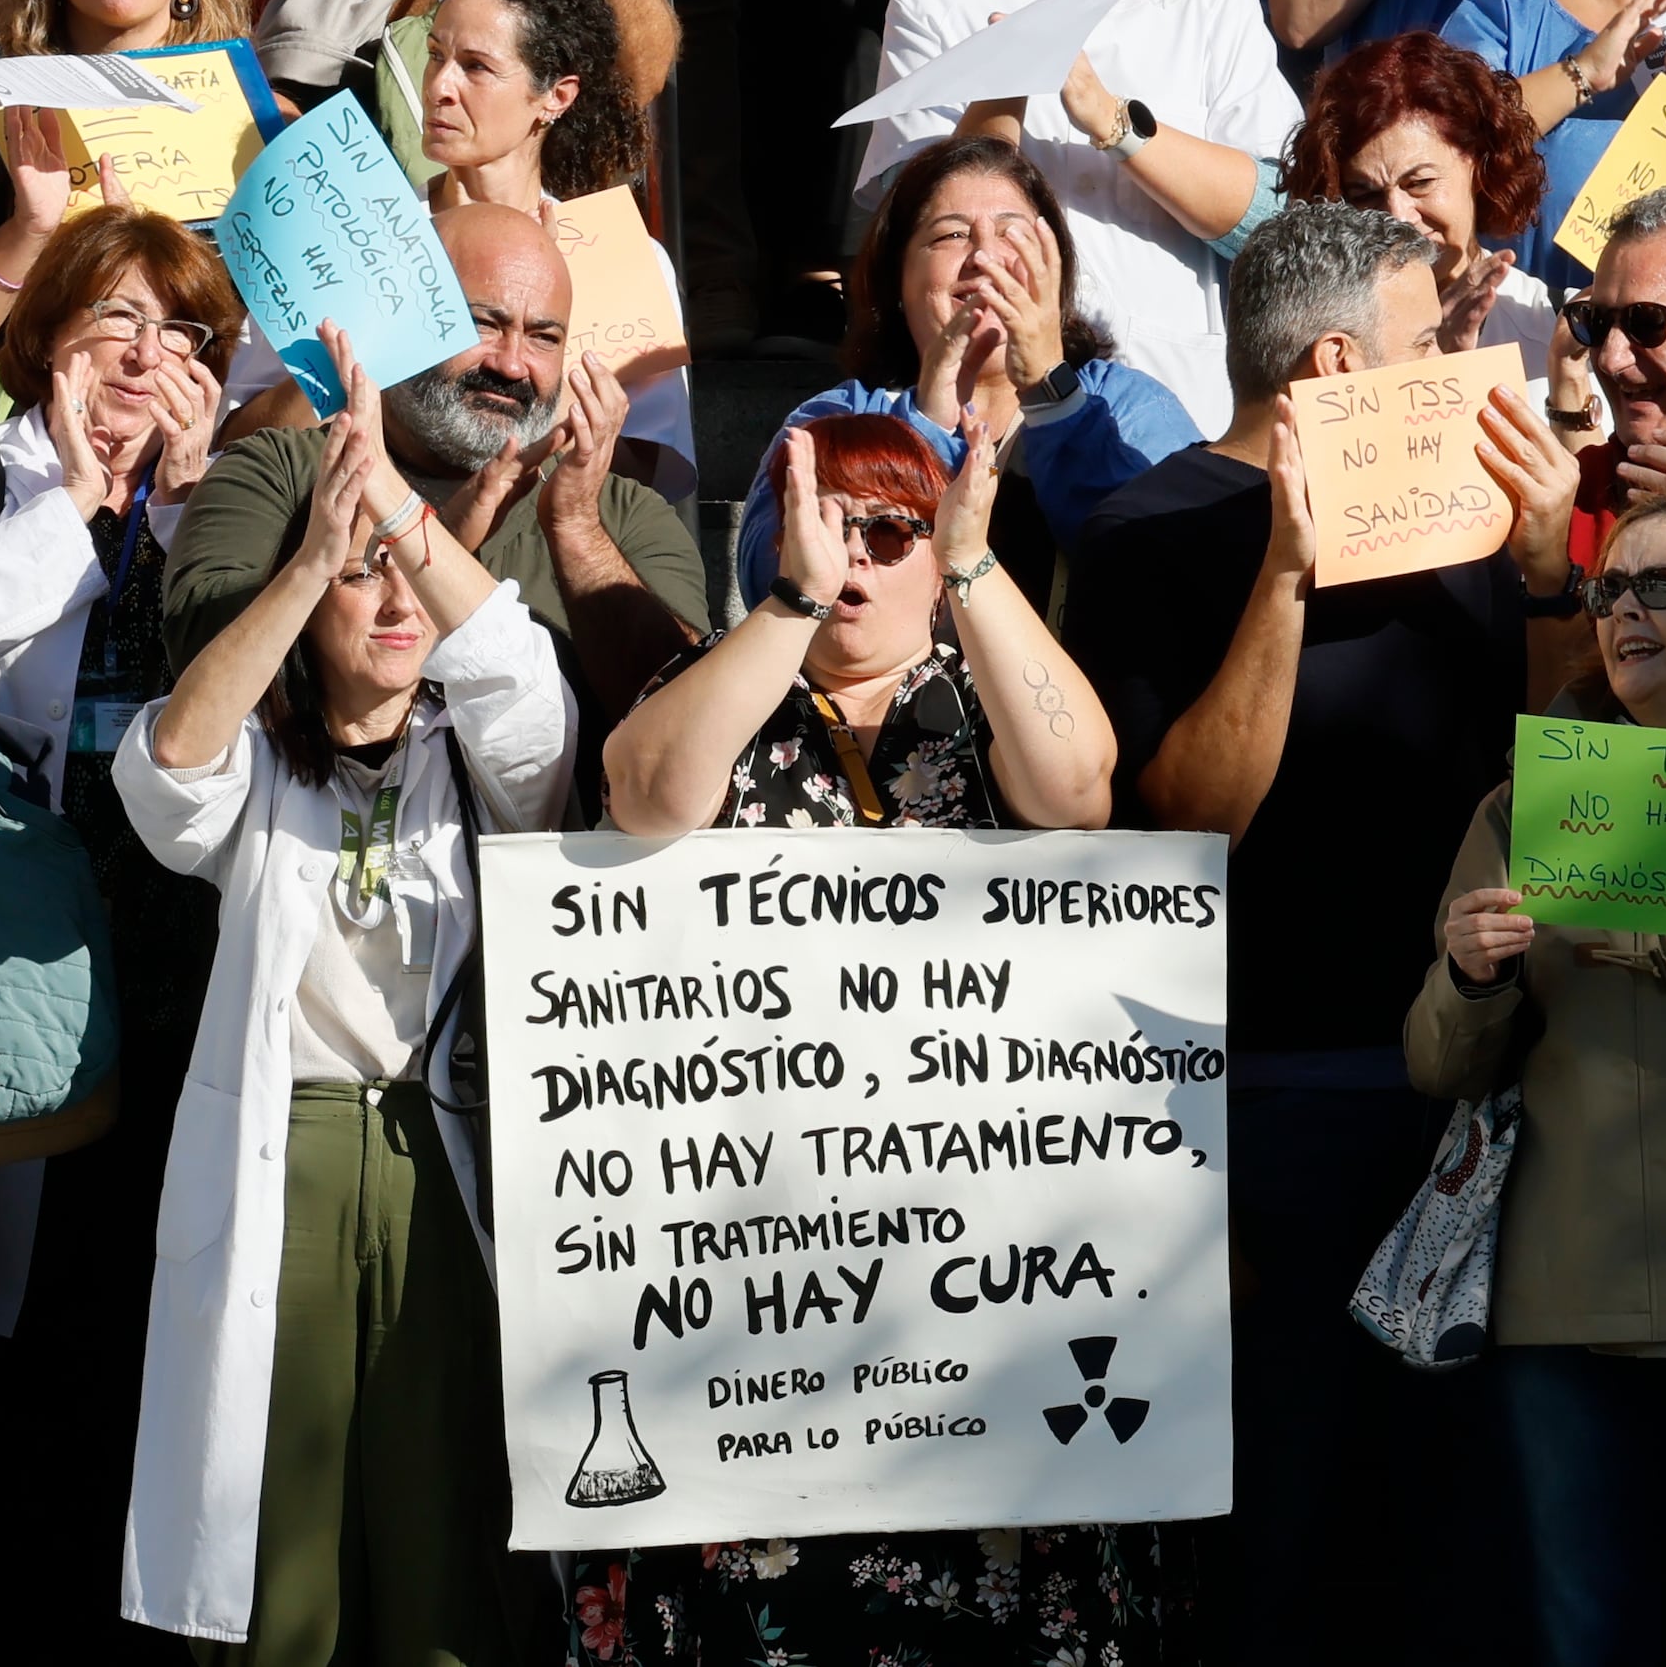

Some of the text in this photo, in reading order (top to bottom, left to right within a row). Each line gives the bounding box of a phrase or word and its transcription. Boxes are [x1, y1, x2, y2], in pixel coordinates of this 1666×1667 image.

[1627, 161, 1655, 191] NO
[264, 176, 345, 291] NO HAY
[1344, 432, 1441, 471] NO HAY
[1570, 790, 1610, 820] NO
[555, 1151, 632, 1197] NO
[661, 1132, 773, 1193] HAY
[634, 1275, 711, 1350] NO
[746, 1258, 883, 1334] HAY
